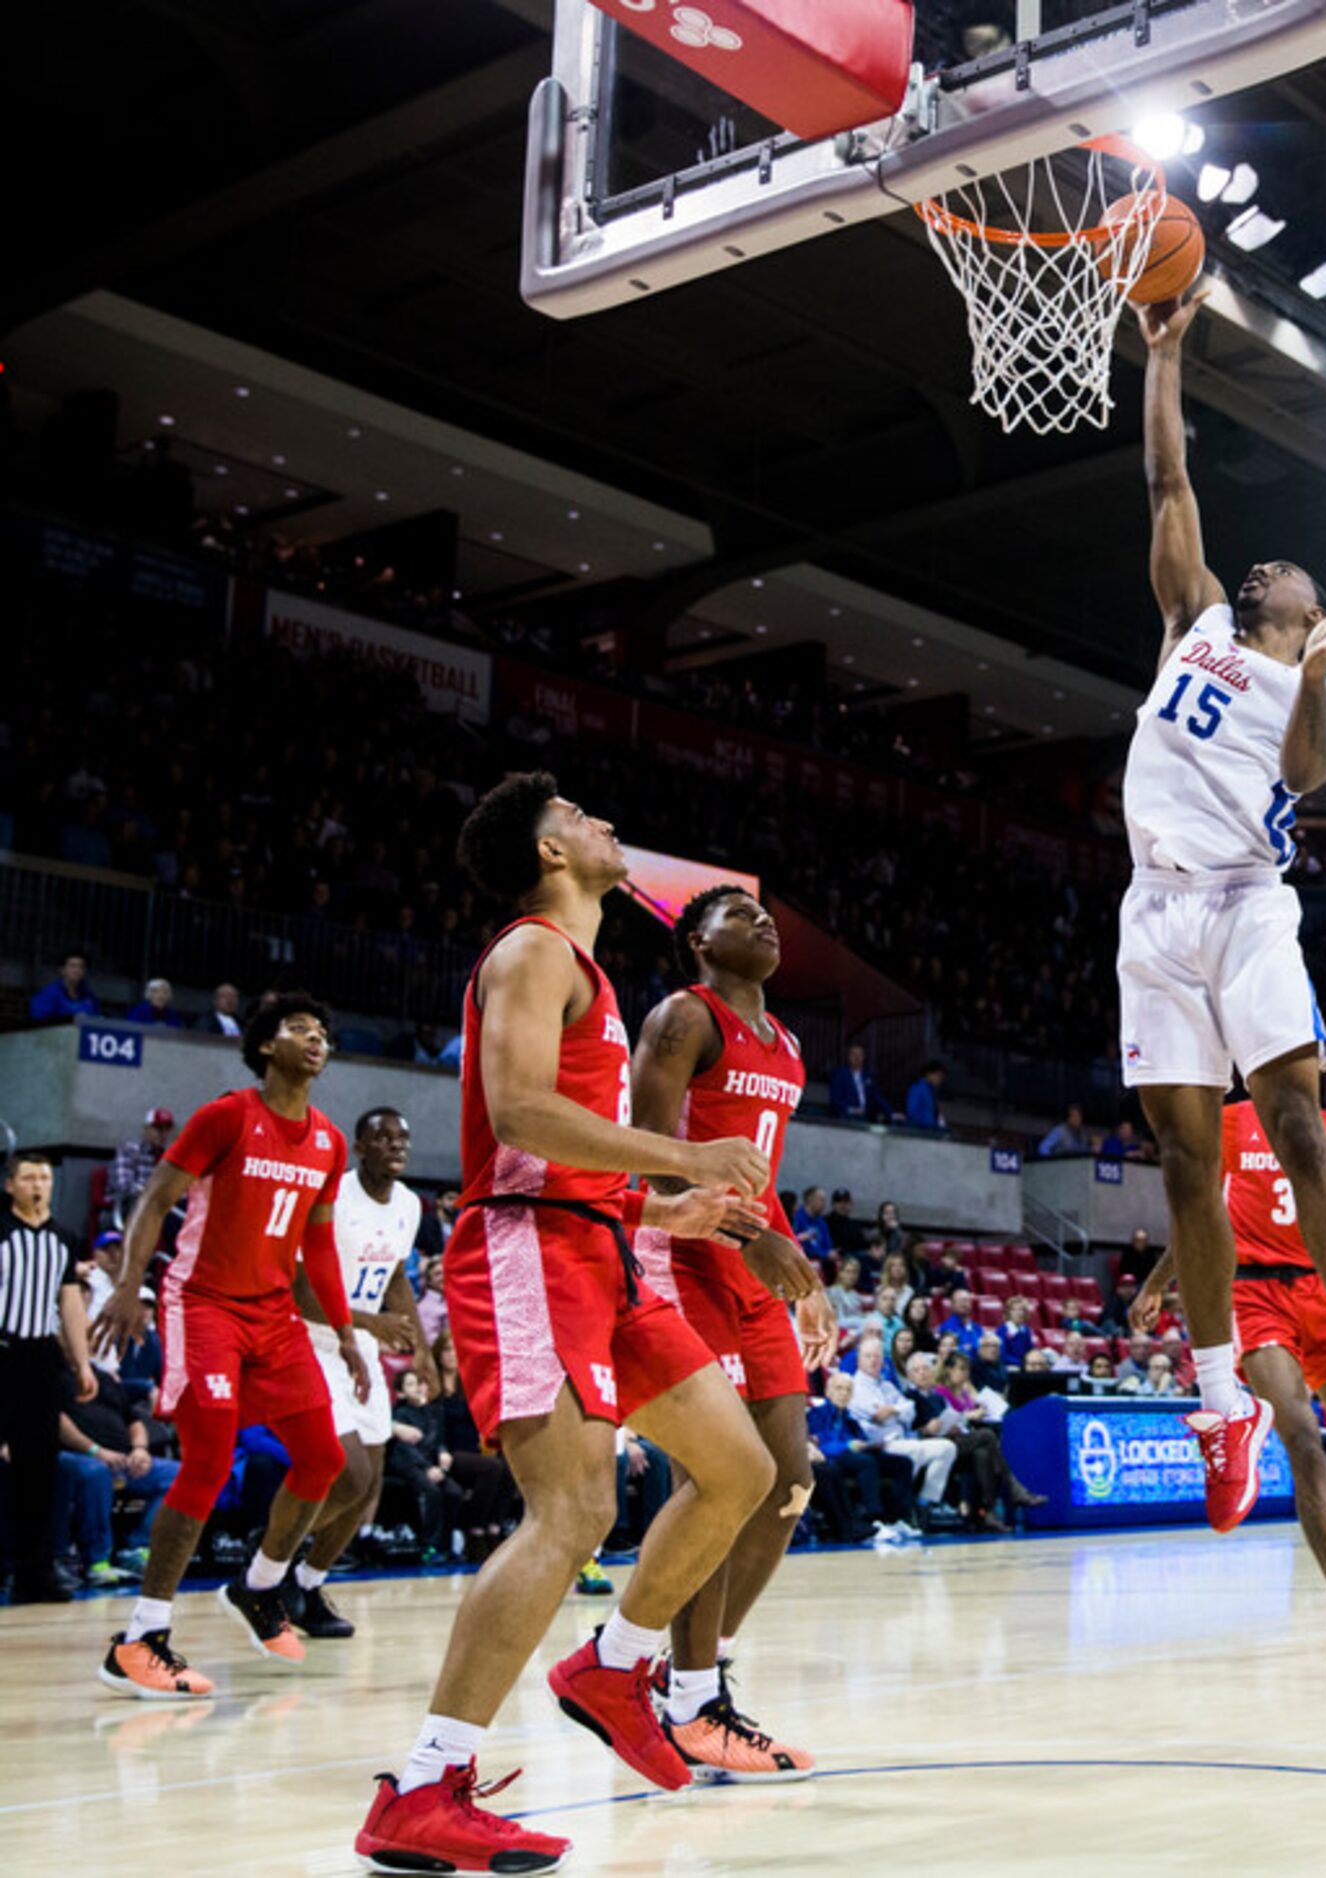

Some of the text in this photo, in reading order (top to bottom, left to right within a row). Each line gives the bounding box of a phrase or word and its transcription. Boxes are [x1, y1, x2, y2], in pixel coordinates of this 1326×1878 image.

[350, 637, 481, 699] BASKETBALL
[1180, 640, 1253, 692] Dallas
[1158, 673, 1232, 740] 15
[88, 1033, 136, 1060] 104
[723, 1069, 803, 1109] HOUSTO
[753, 1109, 779, 1161] 0
[264, 1188, 301, 1238] 11
[1270, 1177, 1298, 1225] 3
[351, 1266, 388, 1300] 13
[1118, 1438, 1192, 1465] LOCKED
